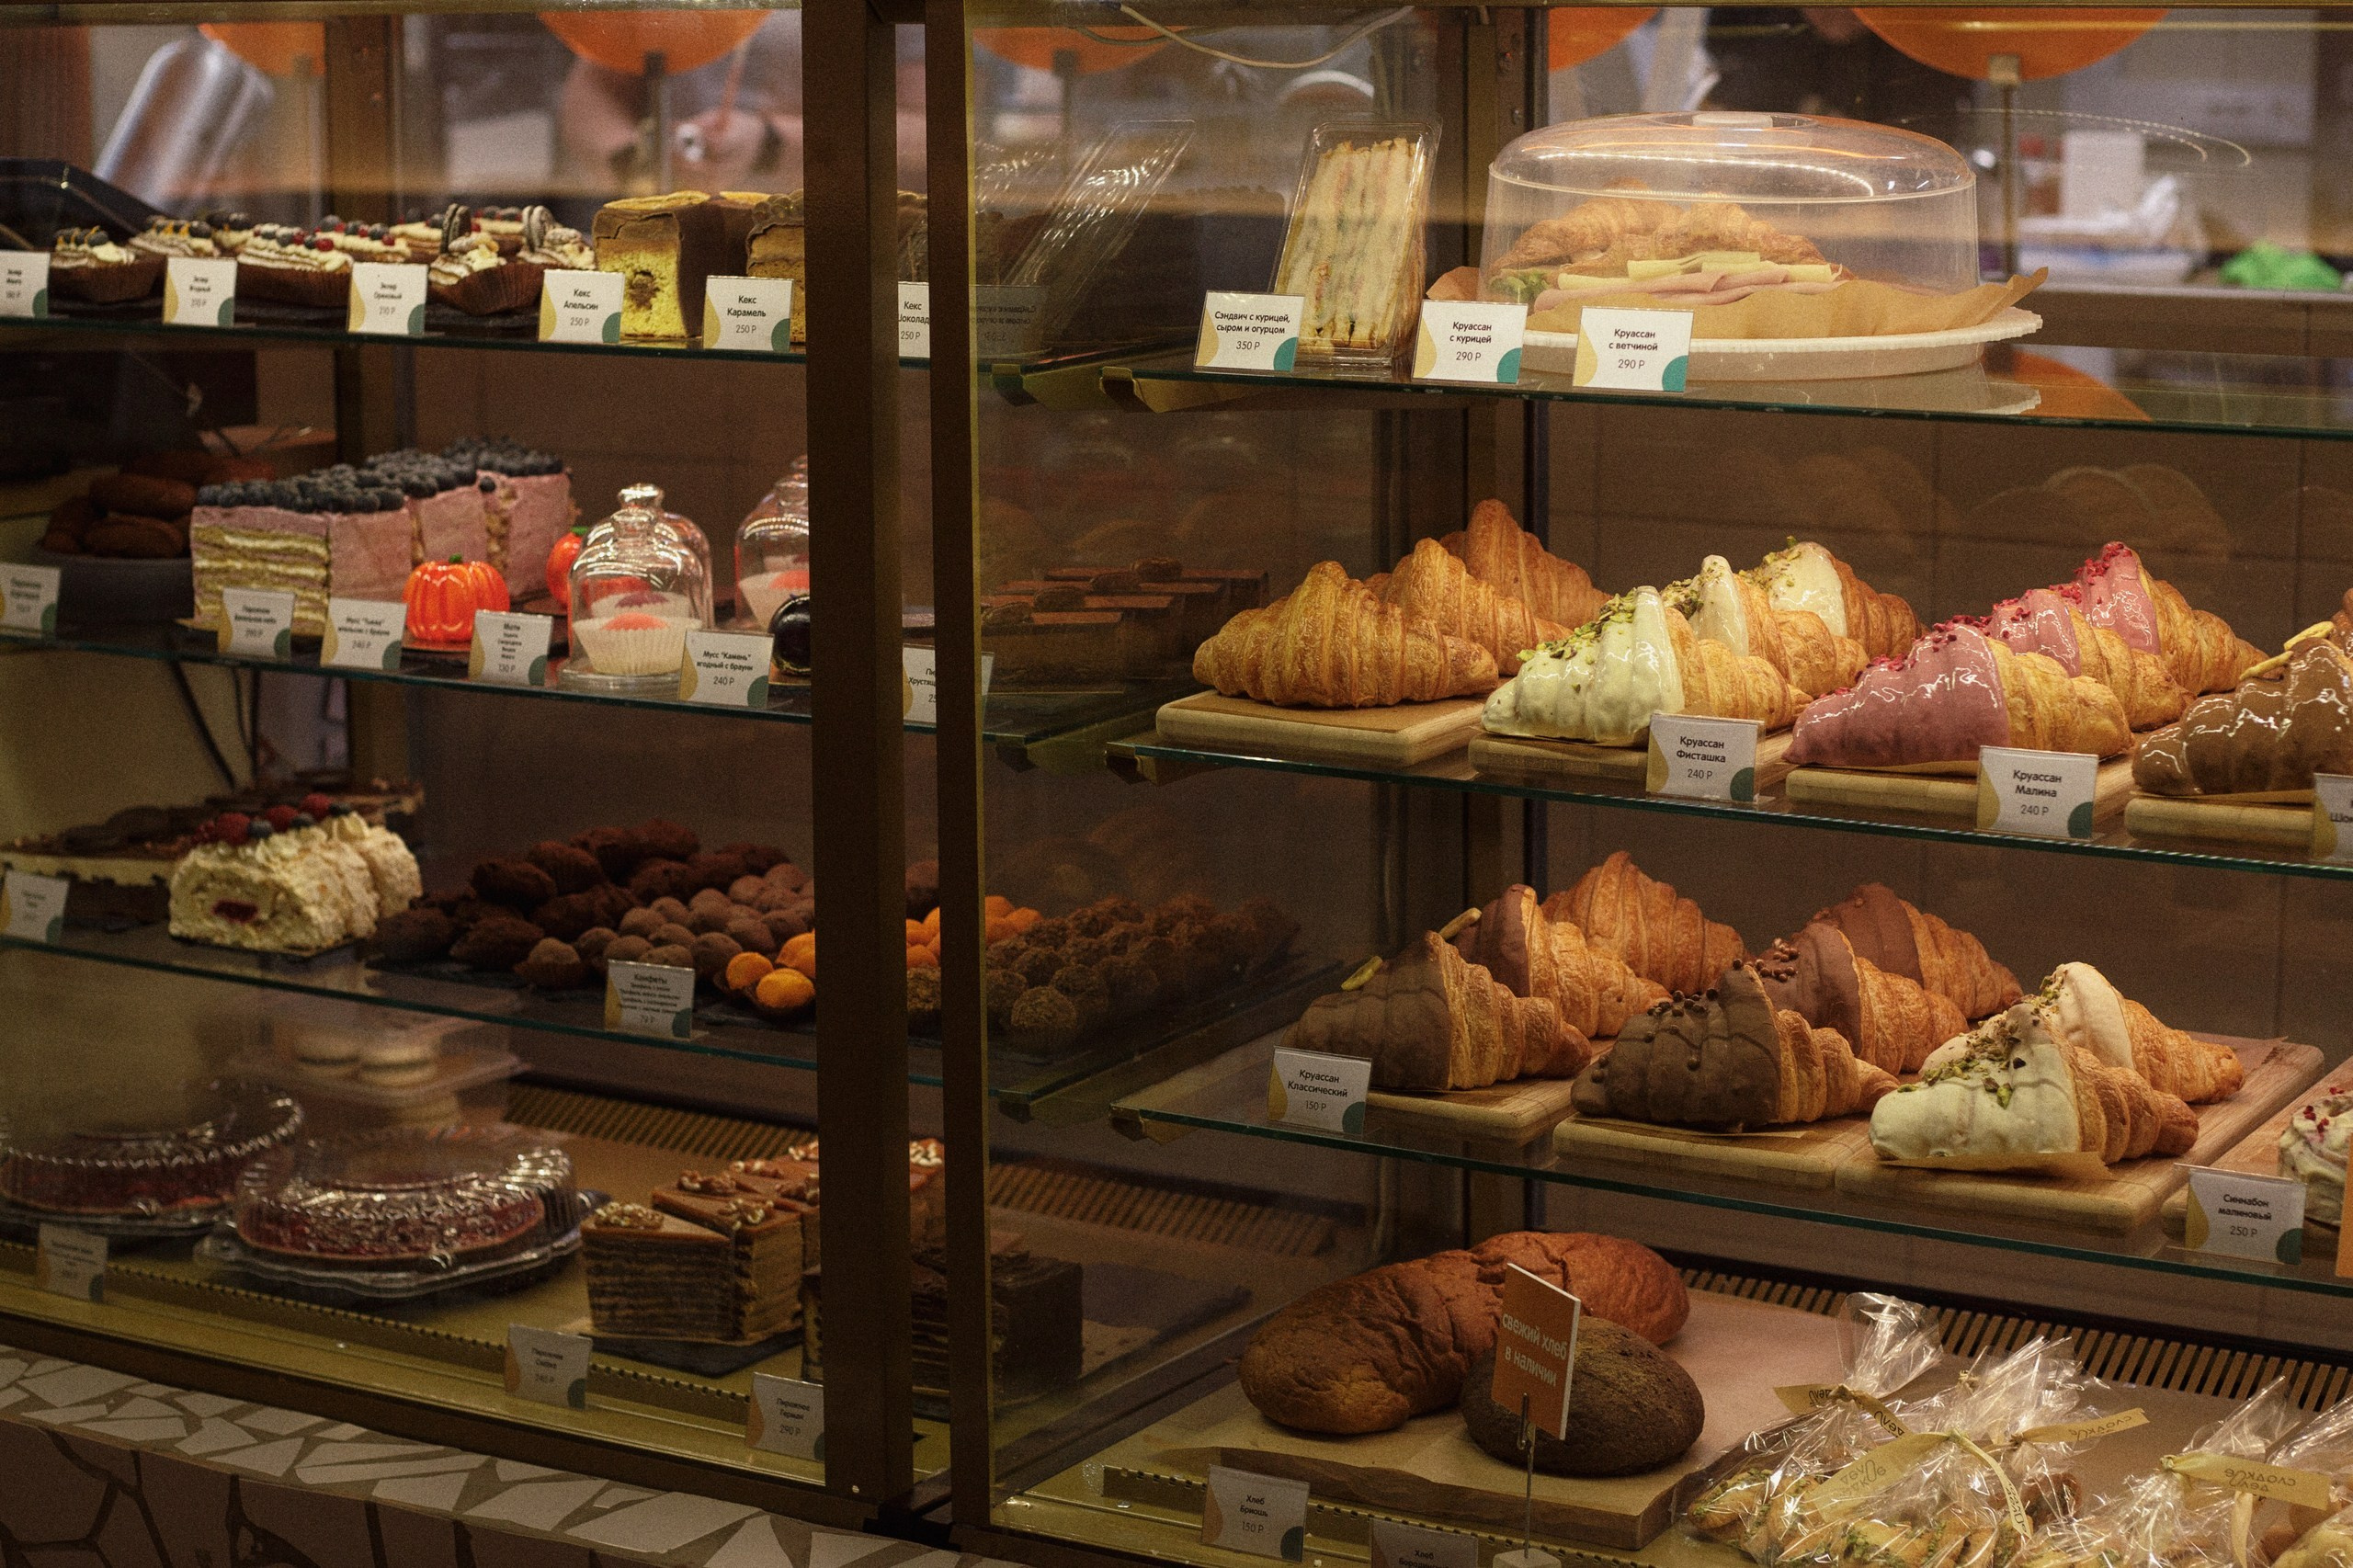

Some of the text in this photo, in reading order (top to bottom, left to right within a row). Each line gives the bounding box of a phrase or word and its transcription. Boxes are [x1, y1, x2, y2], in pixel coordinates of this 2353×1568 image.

[574, 289, 591, 298] Кекс
[738, 295, 757, 304] Кекс
[563, 300, 598, 311] Апельсин
[904, 301, 922, 311] Кекс
[727, 307, 767, 318] Карамель
[1215, 311, 1248, 320] Сэндвич
[1256, 314, 1290, 324] курицей,
[570, 316, 583, 326] 250
[1452, 322, 1492, 331] Круассан
[735, 324, 750, 333] 250
[1217, 324, 1243, 333] сыром
[1252, 325, 1285, 335] огурцом
[1614, 329, 1655, 338] Круассан
[901, 331, 914, 340] 250
[1456, 335, 1491, 344] курицей
[1235, 340, 1252, 350] 350
[1616, 342, 1658, 351] ветчиной
[1456, 351, 1472, 360] 290
[1618, 358, 1636, 369] 290
[730, 664, 754, 672] брауни
[713, 676, 728, 686] 240
[1680, 735, 1724, 748] Круассан
[1677, 750, 1726, 763] Фисташка
[1688, 768, 1704, 779] 240
[2013, 770, 2062, 783] Круассан
[2015, 785, 2057, 798] Малина
[2020, 804, 2039, 815] 240
[1300, 1069, 1340, 1083] Круассан
[1288, 1081, 1347, 1097] Классический
[1305, 1100, 1319, 1110] 150
[2222, 1193, 2268, 1208] Синнабон
[2218, 1208, 2272, 1221] малиновый
[2230, 1226, 2248, 1237] 250
[1502, 1313, 1568, 1360] свежий хлеб
[1506, 1346, 1557, 1387] в наличии
[1246, 1494, 1265, 1506] Хлеб
[1239, 1505, 1268, 1517] Бриошь
[1242, 1522, 1256, 1533] 150
[1414, 1550, 1434, 1560] Хлеб
